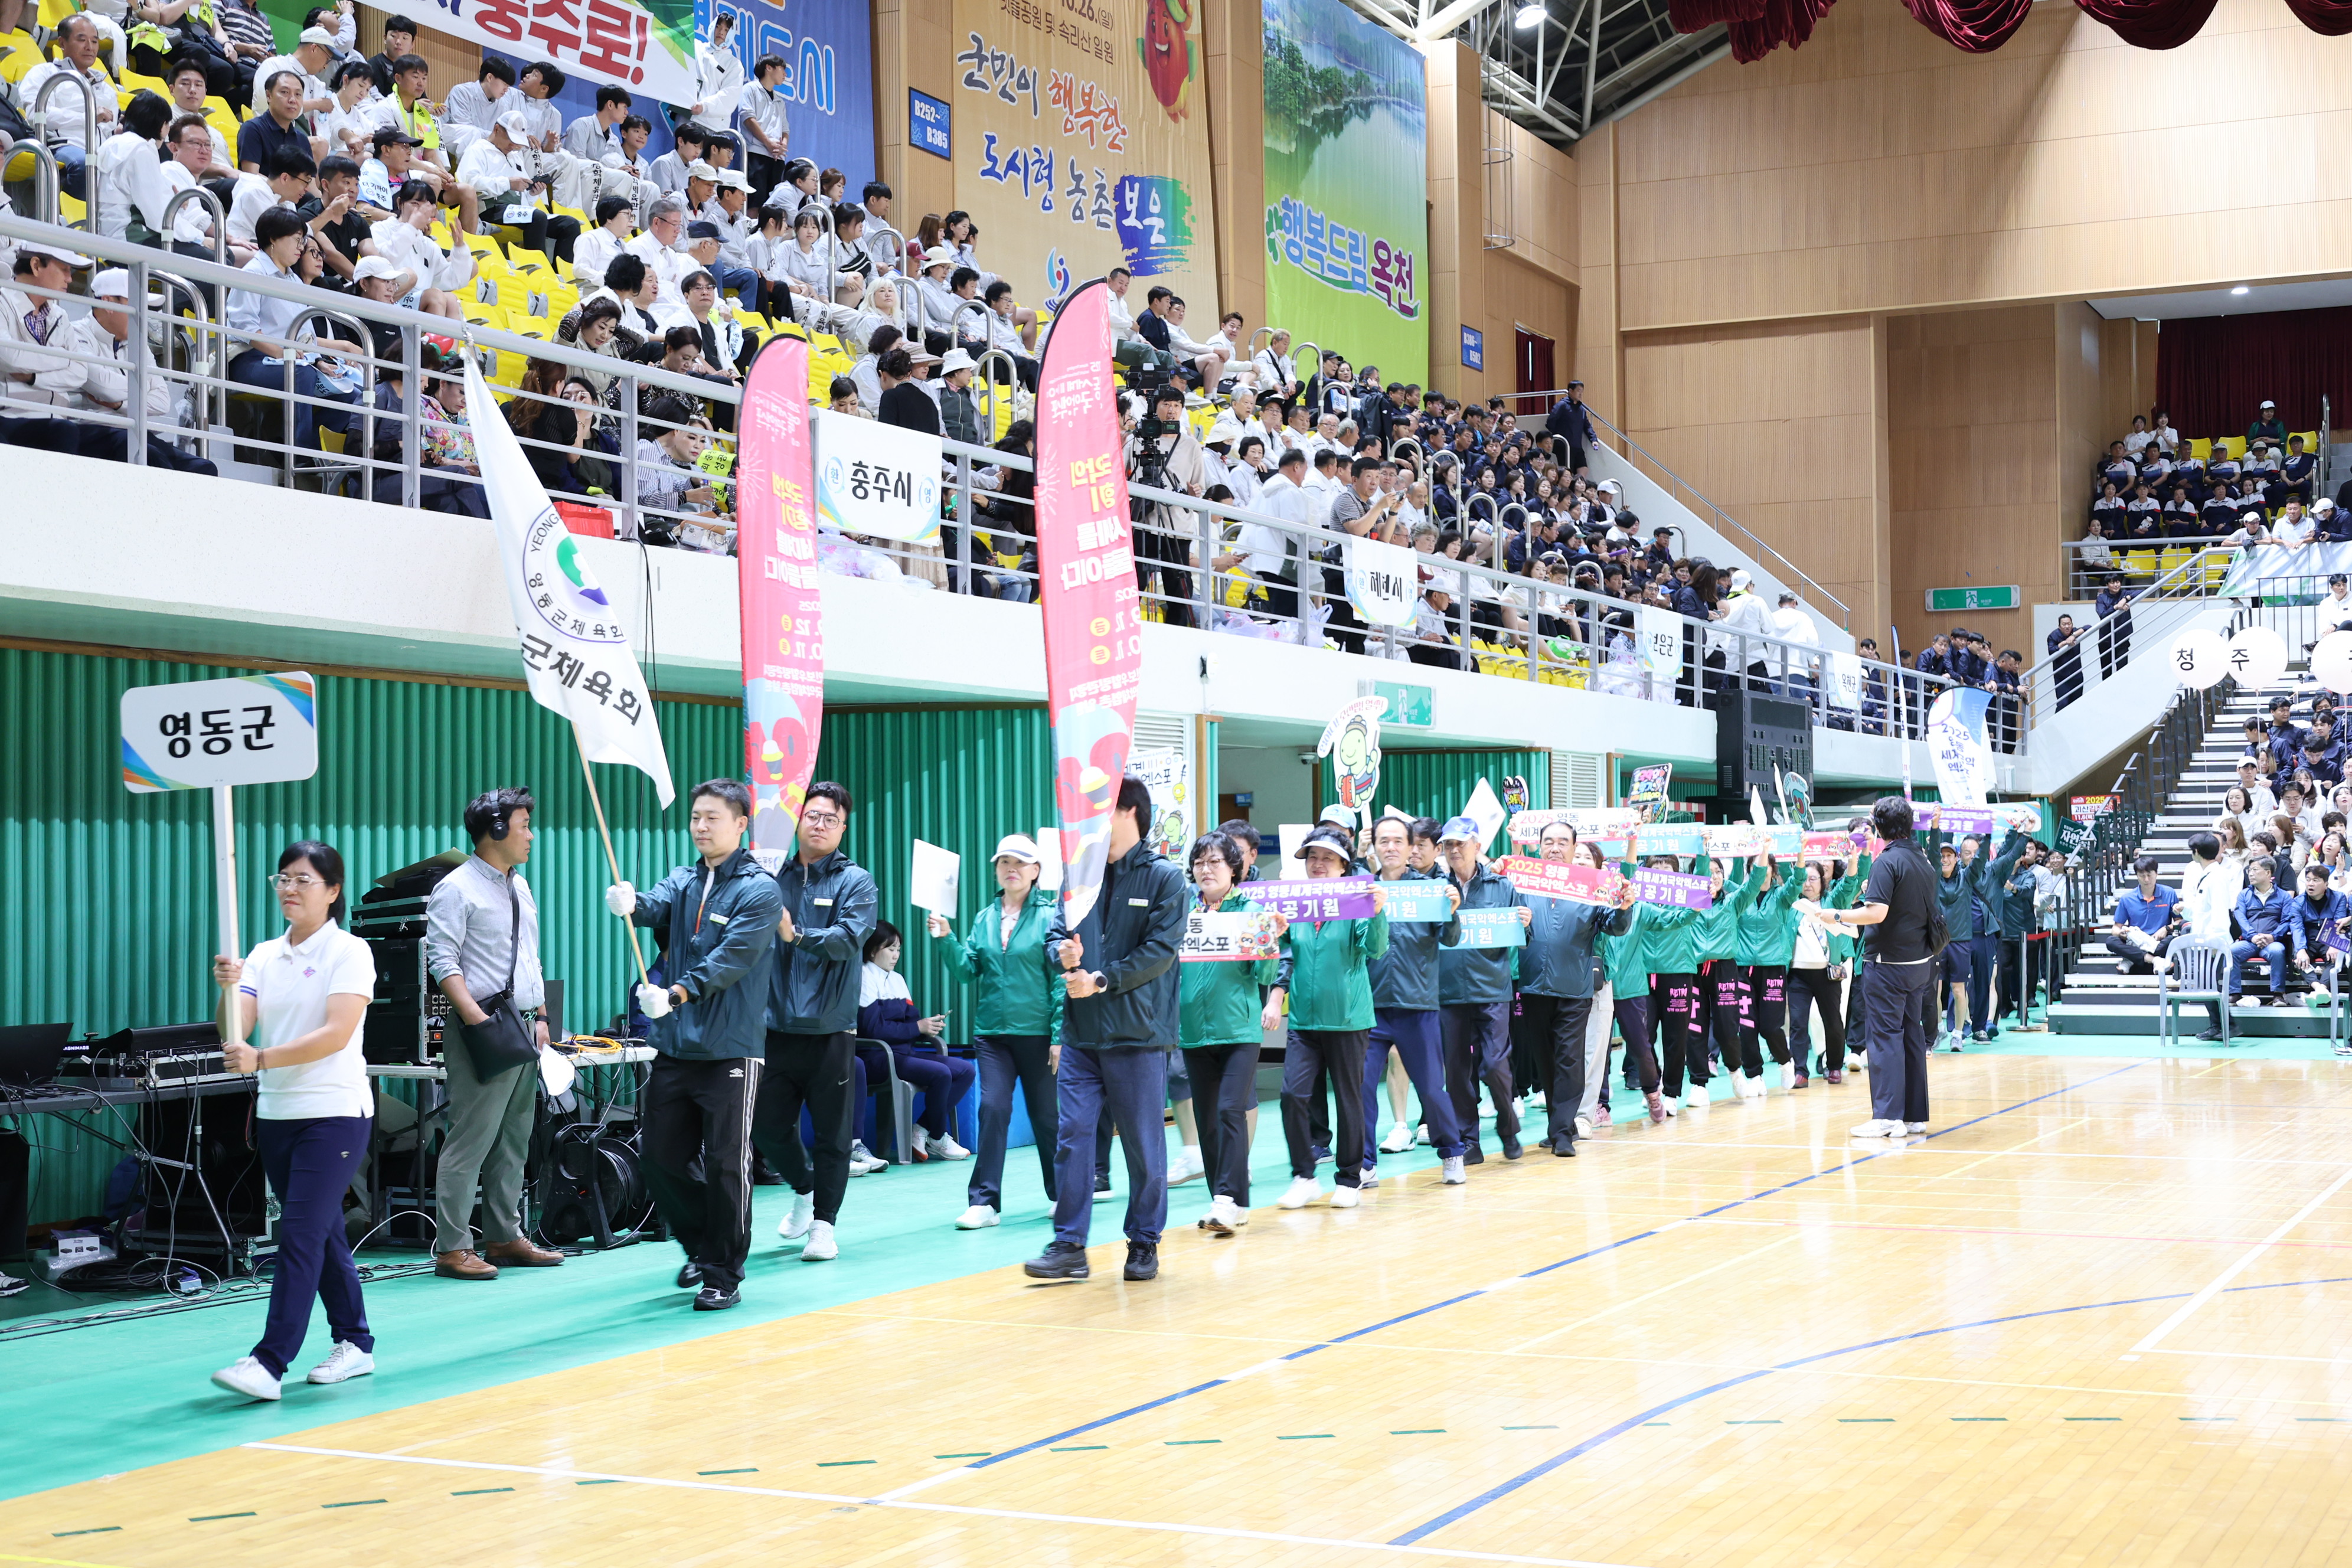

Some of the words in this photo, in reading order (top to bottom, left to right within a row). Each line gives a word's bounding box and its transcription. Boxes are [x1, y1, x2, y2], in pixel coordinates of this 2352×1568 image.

[1046, 12, 1056, 37] 및
[1059, 20, 1090, 54] 속리산
[1093, 36, 1113, 65] 일원
[957, 32, 1040, 117] 군민이
[1048, 70, 1128, 152] 행복한
[914, 99, 941, 124] B252~
[926, 126, 948, 150] B385
[979, 133, 1054, 211] 도시형
[1066, 156, 1114, 230] 농촌
[1122, 179, 1167, 245] 보은
[1281, 196, 1367, 294] 행복드림
[1371, 240, 1414, 316] 옥천
[851, 460, 912, 507] 충주시
[2177, 648, 2194, 671] 청
[2231, 649, 2250, 671] 주
[1841, 674, 1857, 693] 옥천군
[159, 705, 276, 759] 영동군
[1141, 768, 1171, 790] 엑스포
[1520, 814, 1554, 824] 2025
[1557, 812, 1579, 823] 영동
[1520, 824, 1600, 838] 세계스포
[1506, 858, 1543, 875] 2025
[1544, 864, 1570, 880] 영동
[1634, 870, 1709, 890] 영동세계국악엑스포
[1268, 880, 1368, 899] 영동세계국악엑스포
[1506, 871, 1589, 897] 세계국악엑스포
[1187, 917, 1204, 935] 동
[1670, 988, 1688, 998] RETRO
[1717, 982, 1736, 991] RETRO
[1766, 978, 1783, 988] RETRO
